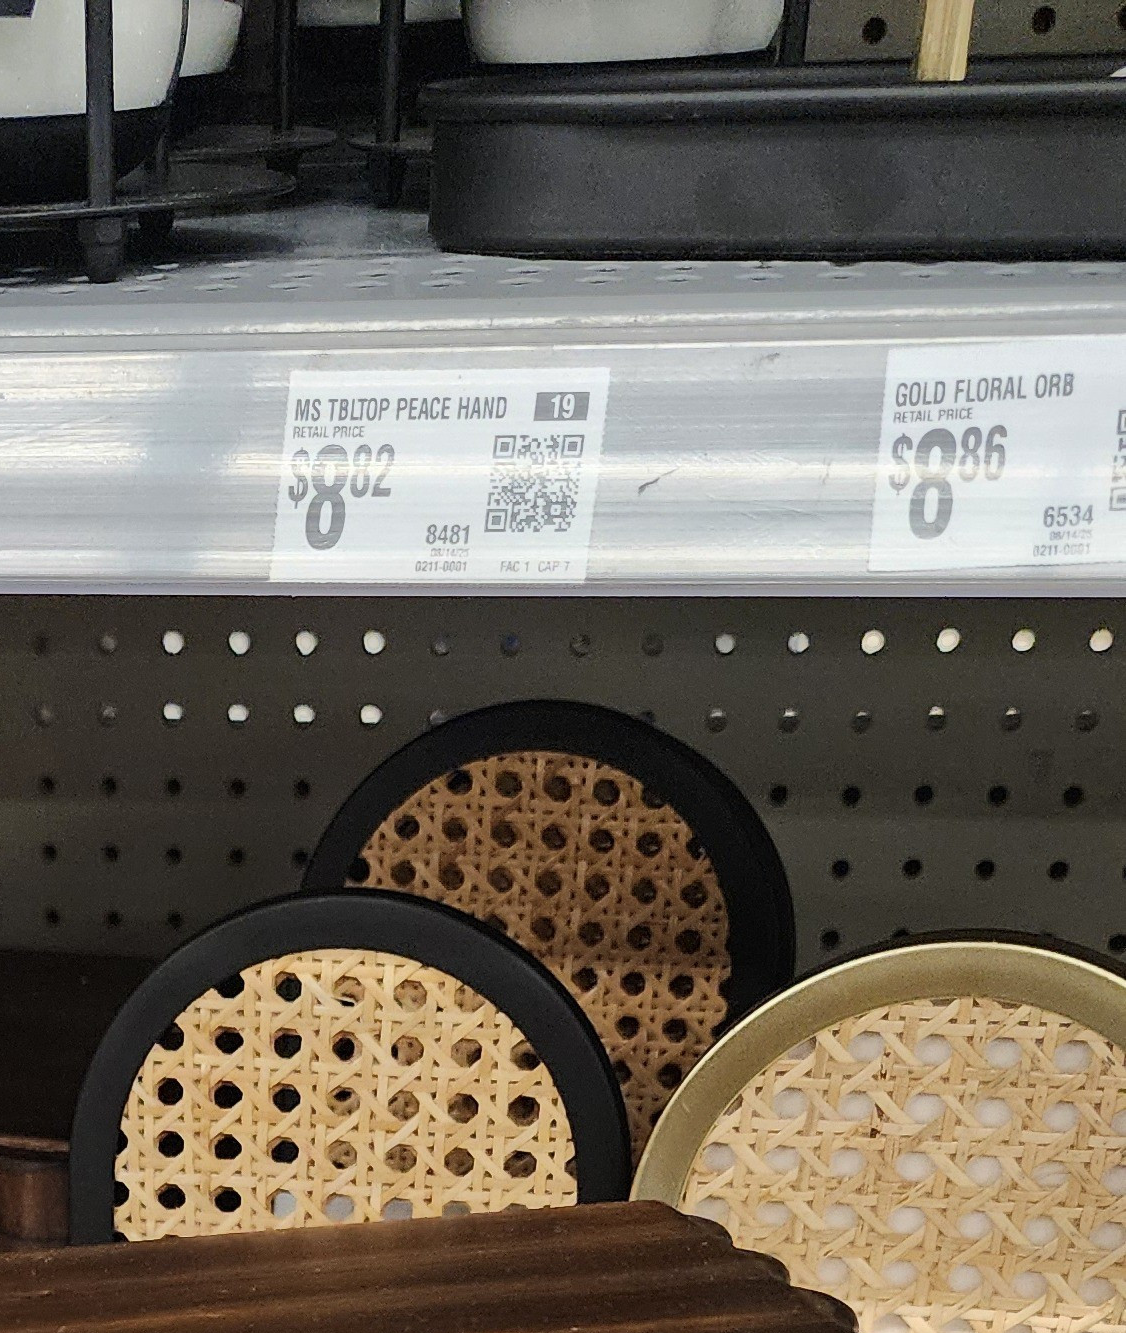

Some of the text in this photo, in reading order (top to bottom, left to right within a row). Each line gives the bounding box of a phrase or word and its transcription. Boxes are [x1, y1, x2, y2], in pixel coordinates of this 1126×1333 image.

[895, 373, 1075, 407] GOLD FLORAL ORB
[294, 395, 508, 422] MS TBLTOP PEACE HAND
[551, 393, 577, 419] 19
[893, 408, 974, 424] RETAIL PRICE
[292, 425, 366, 438] RETAIL PRICE
[1043, 505, 1094, 528] 6534
[425, 524, 470, 545] 8481
[499, 560, 571, 573] FAC 1 CAP 7
